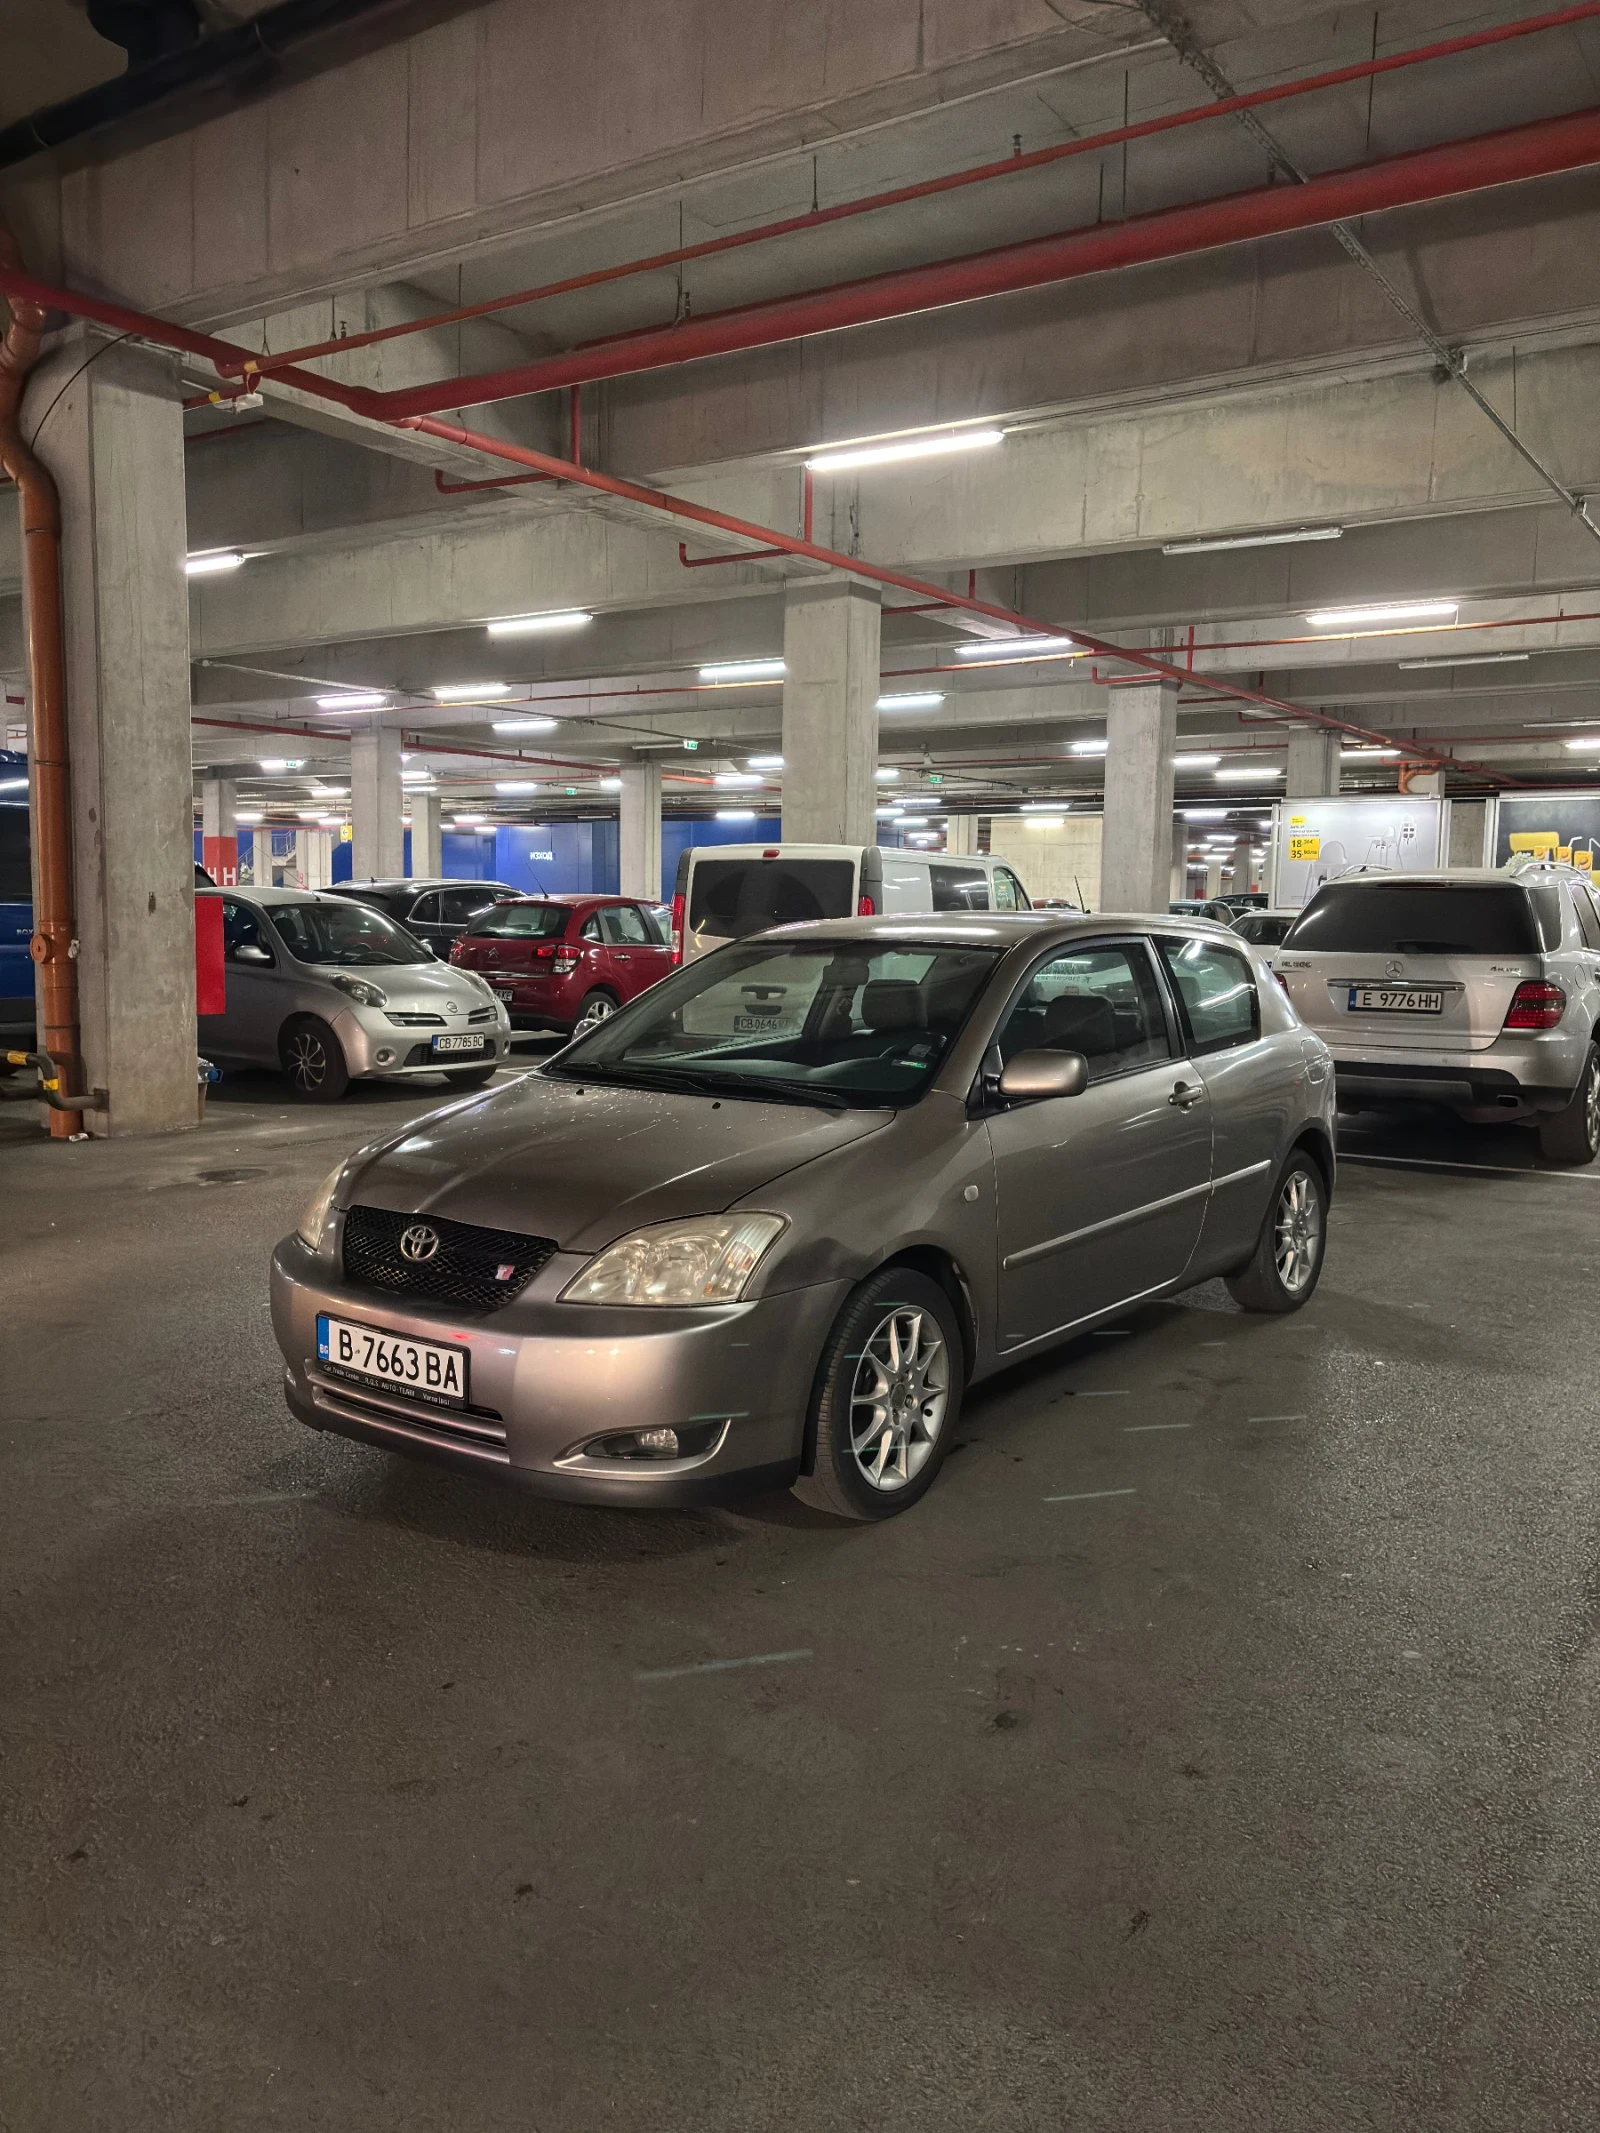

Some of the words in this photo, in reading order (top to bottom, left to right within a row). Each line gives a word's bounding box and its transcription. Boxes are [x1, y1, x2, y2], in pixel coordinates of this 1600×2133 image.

[1362, 992, 1373, 1006] E
[1380, 992, 1416, 1008] 9776
[1418, 994, 1439, 1009] HH
[339, 1328, 353, 1362] B
[363, 1335, 420, 1381] 7663
[426, 1351, 460, 1392] BA
